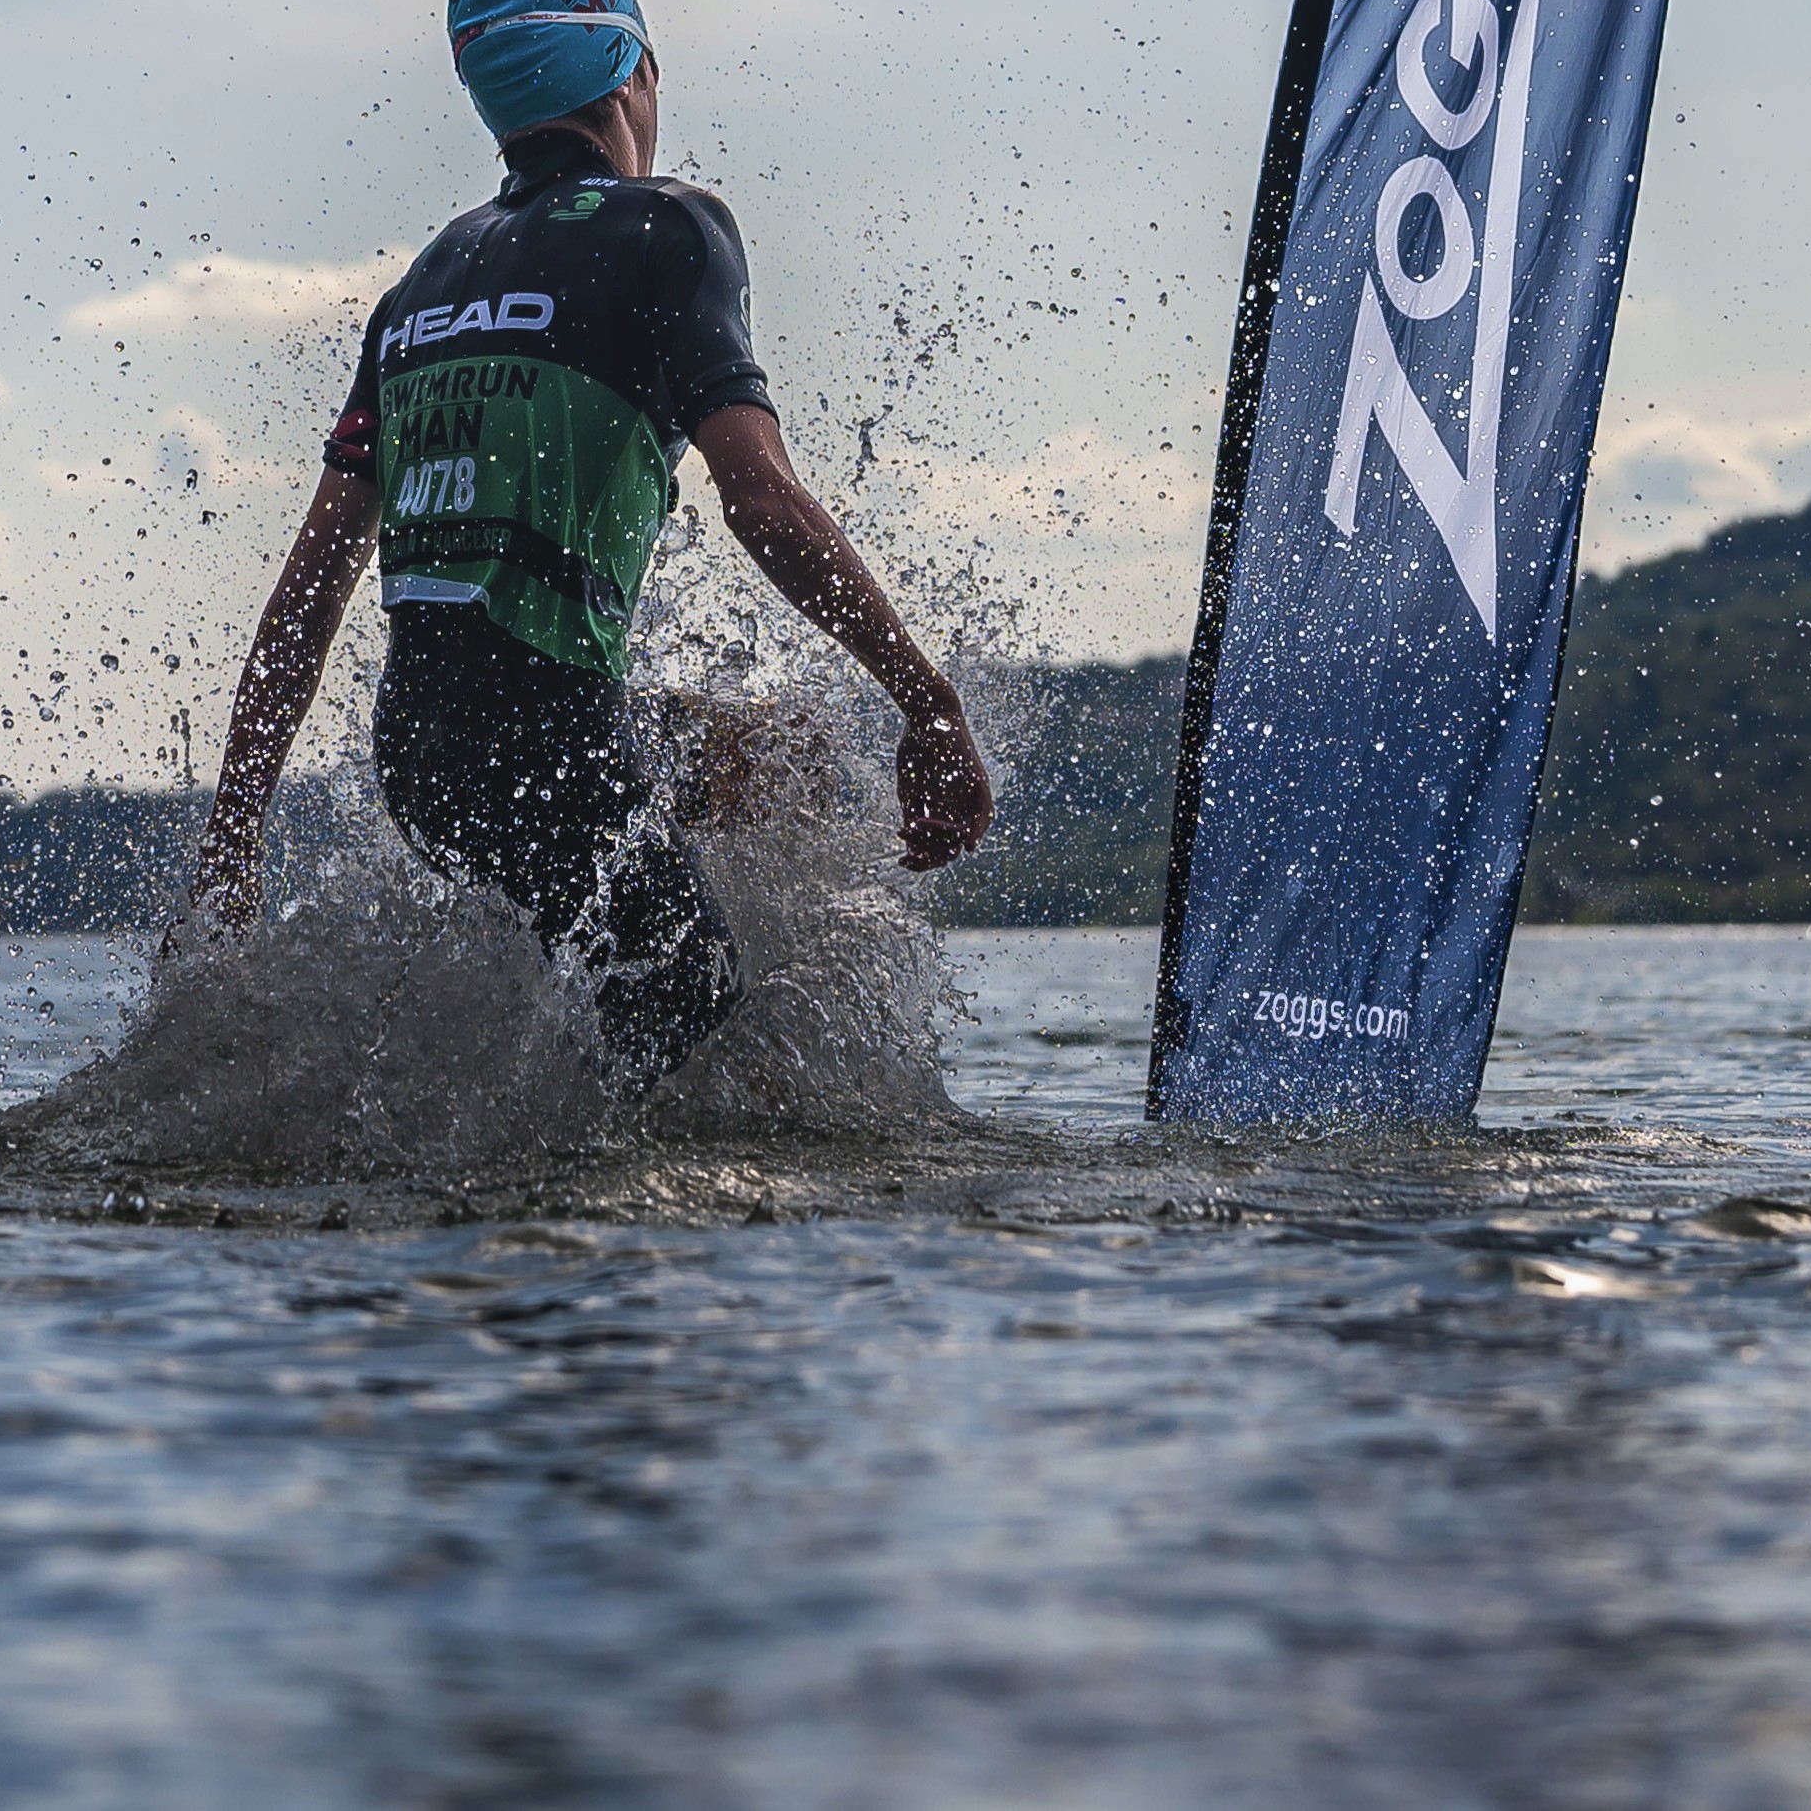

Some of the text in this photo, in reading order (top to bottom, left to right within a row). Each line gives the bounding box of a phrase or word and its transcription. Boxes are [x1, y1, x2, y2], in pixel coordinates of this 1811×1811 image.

[379, 292, 555, 362] HEAD
[398, 403, 485, 460] MAN
[395, 456, 476, 519] 4078
[1253, 990, 1410, 1040] zoggs.com
